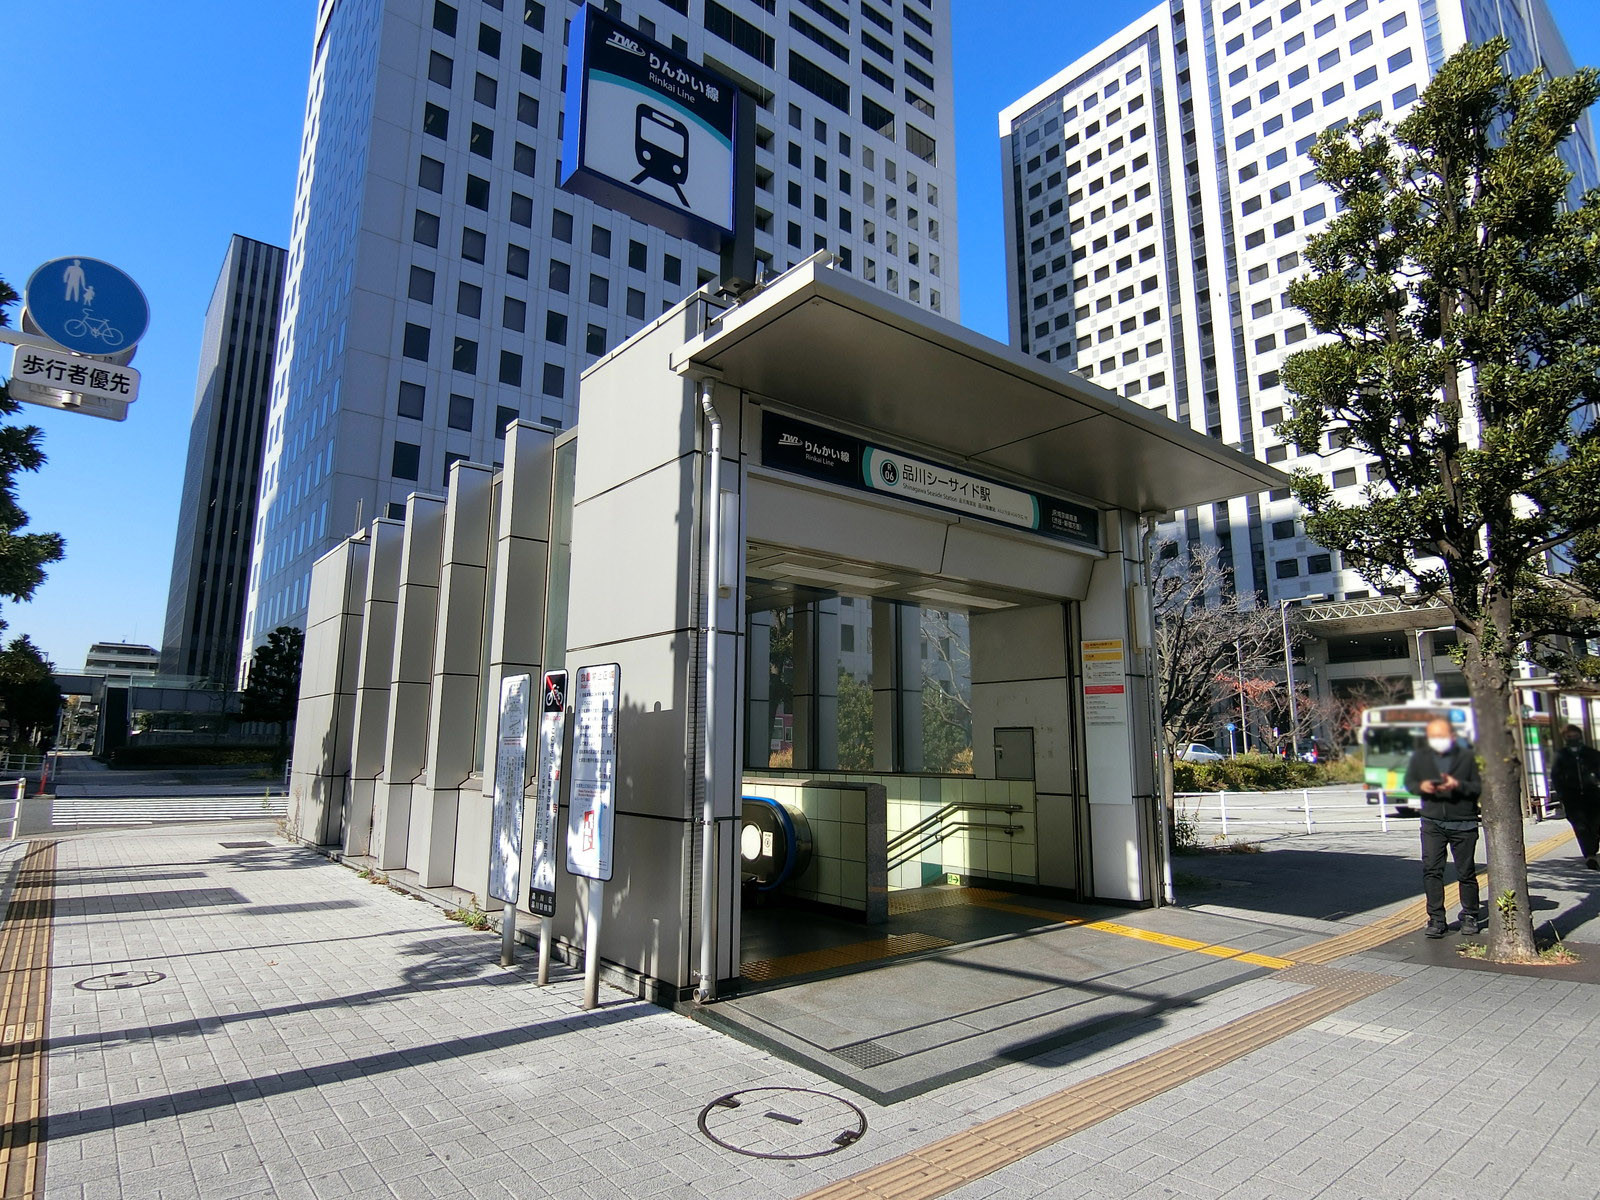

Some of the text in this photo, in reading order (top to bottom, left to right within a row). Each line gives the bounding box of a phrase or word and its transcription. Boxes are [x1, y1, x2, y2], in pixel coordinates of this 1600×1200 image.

[649, 53, 720, 103] りんかい線
[649, 71, 696, 104] Rinkai Line
[23, 354, 130, 395] 歩行者優先
[804, 440, 850, 463] りんかい線
[805, 453, 835, 467] Rinkai Line
[884, 470, 895, 481] 06
[902, 464, 991, 503] 品川シーサイド駅
[903, 483, 958, 502] Shinagawa Seaside Station
